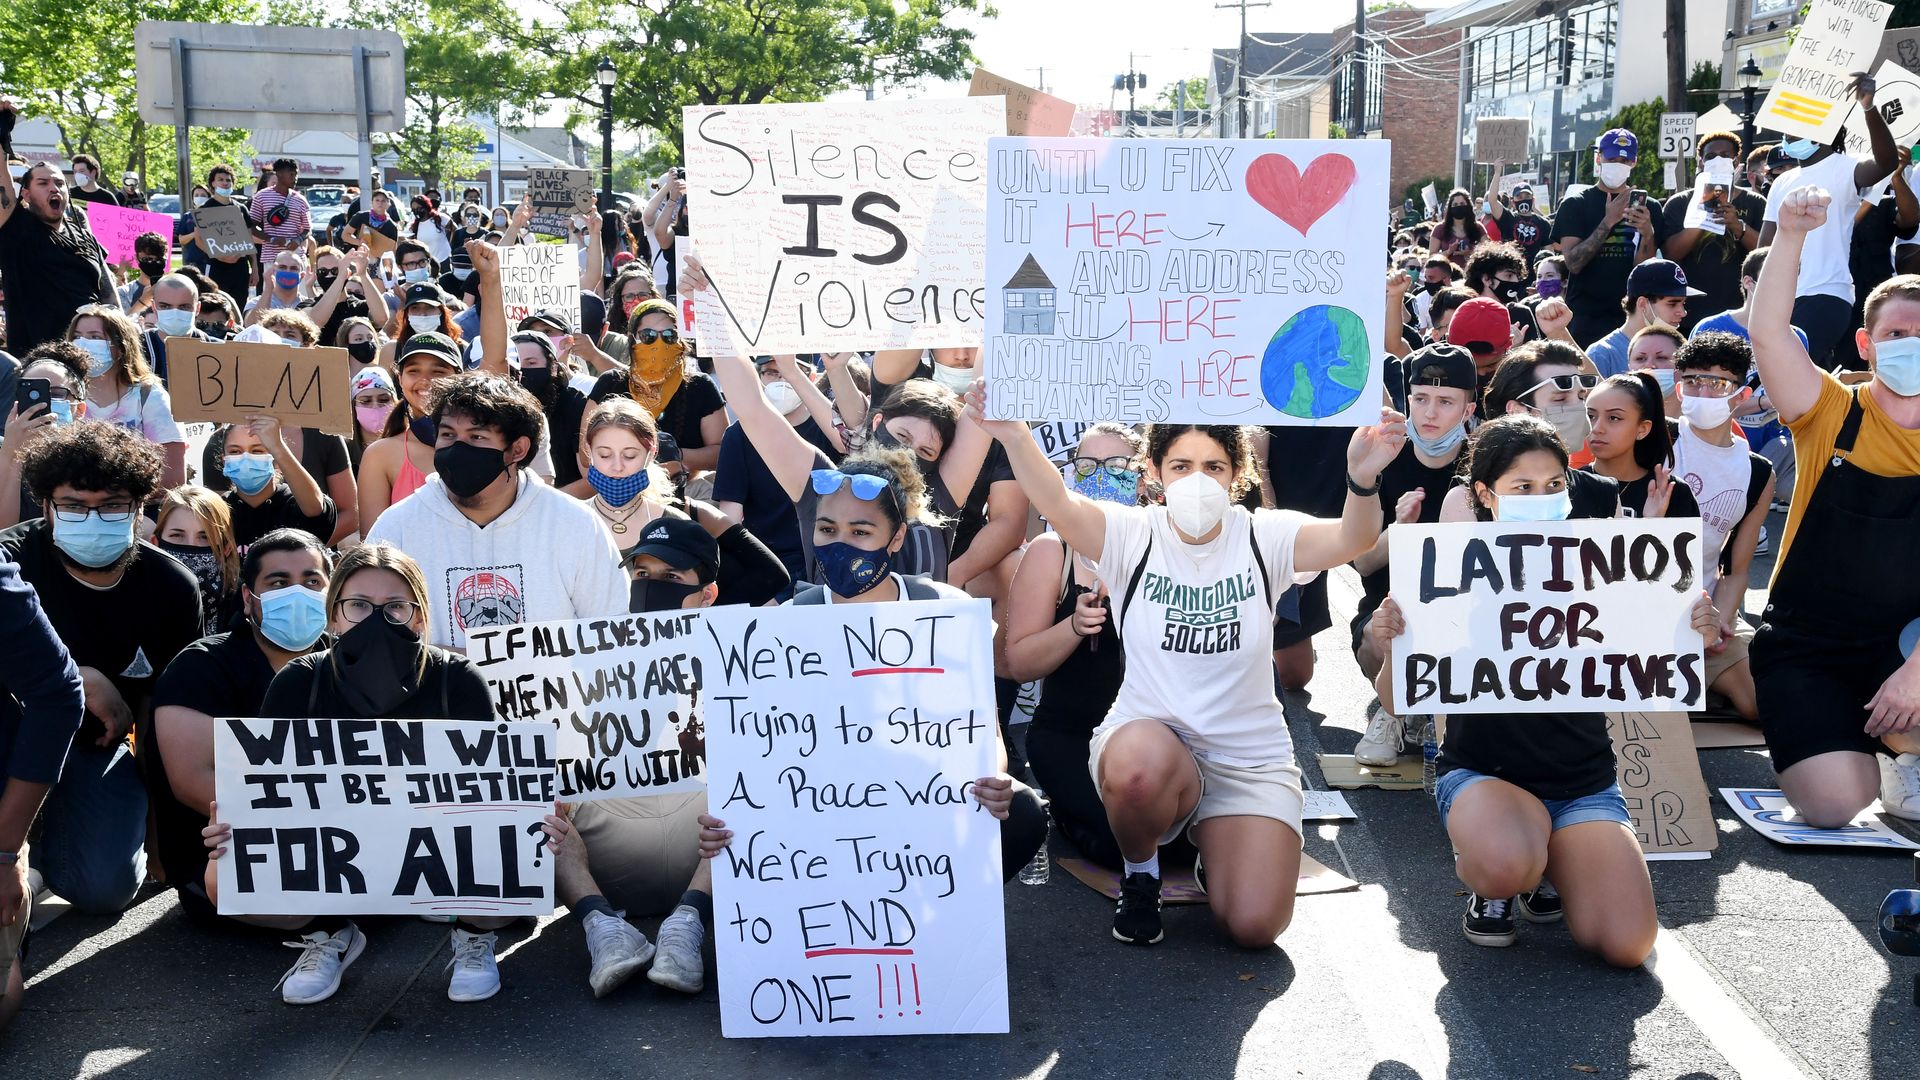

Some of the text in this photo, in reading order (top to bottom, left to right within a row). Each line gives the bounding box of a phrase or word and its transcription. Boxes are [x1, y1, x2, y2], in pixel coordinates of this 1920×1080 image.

[1800, 37, 1821, 56] THE
[1828, 16, 1854, 39] WITH
[1826, 46, 1855, 67] LAST
[1481, 122, 1522, 136] BLACK
[1483, 136, 1516, 147] LIVES
[1663, 118, 1694, 126] SPEED
[1665, 127, 1690, 135] LIMIT
[698, 110, 980, 197] Silence
[1663, 136, 1692, 152] 30
[533, 180, 564, 190] LIVES
[535, 171, 570, 182] BLACK
[997, 146, 1235, 194] UNTIL U FIX
[119, 211, 148, 221] FUCK
[533, 190, 574, 202] MATTER
[125, 223, 146, 233] YOU
[194, 212, 236, 229] Everyone
[216, 227, 236, 237] VS
[782, 191, 909, 266] IS
[1005, 198, 1167, 249] IT HERE
[500, 265, 556, 283] TIRED OF
[502, 247, 516, 265] IF
[1069, 249, 1346, 295] AND ADDRESS
[505, 304, 529, 321] CISM
[533, 284, 577, 306] ABOUT
[700, 260, 985, 347] Violence
[1072, 293, 1242, 345] IT HERE
[196, 354, 323, 412] BLM
[991, 335, 1256, 399] NOTHING HERE
[991, 378, 1172, 422] CHANGES
[1039, 421, 1088, 454] BLA
[647, 532, 670, 540] adidas
[870, 560, 889, 584] MADRID
[1419, 532, 1698, 604] LATINOS
[1143, 570, 1256, 612] FARMINGDALE
[1168, 608, 1234, 625] STATE
[1499, 602, 1605, 651] FOR
[470, 613, 700, 667] IF ALL LIVES MAT
[706, 615, 956, 687] We're NOT
[1160, 621, 1241, 655] SOCCER
[572, 660, 637, 707] WHY
[1405, 653, 1702, 708] BLACK LIVES
[226, 719, 427, 767] WHEN
[570, 708, 651, 759] YOU
[713, 696, 986, 758] Trying to Start
[243, 773, 328, 810] IT
[340, 773, 392, 805] BE
[555, 757, 617, 797] ING
[721, 771, 765, 810] A
[777, 765, 888, 813] Race
[232, 821, 550, 899] FOR ALL?
[725, 830, 956, 898] We're Trying
[730, 897, 917, 950] to END
[750, 962, 922, 1026] ONE !!!
